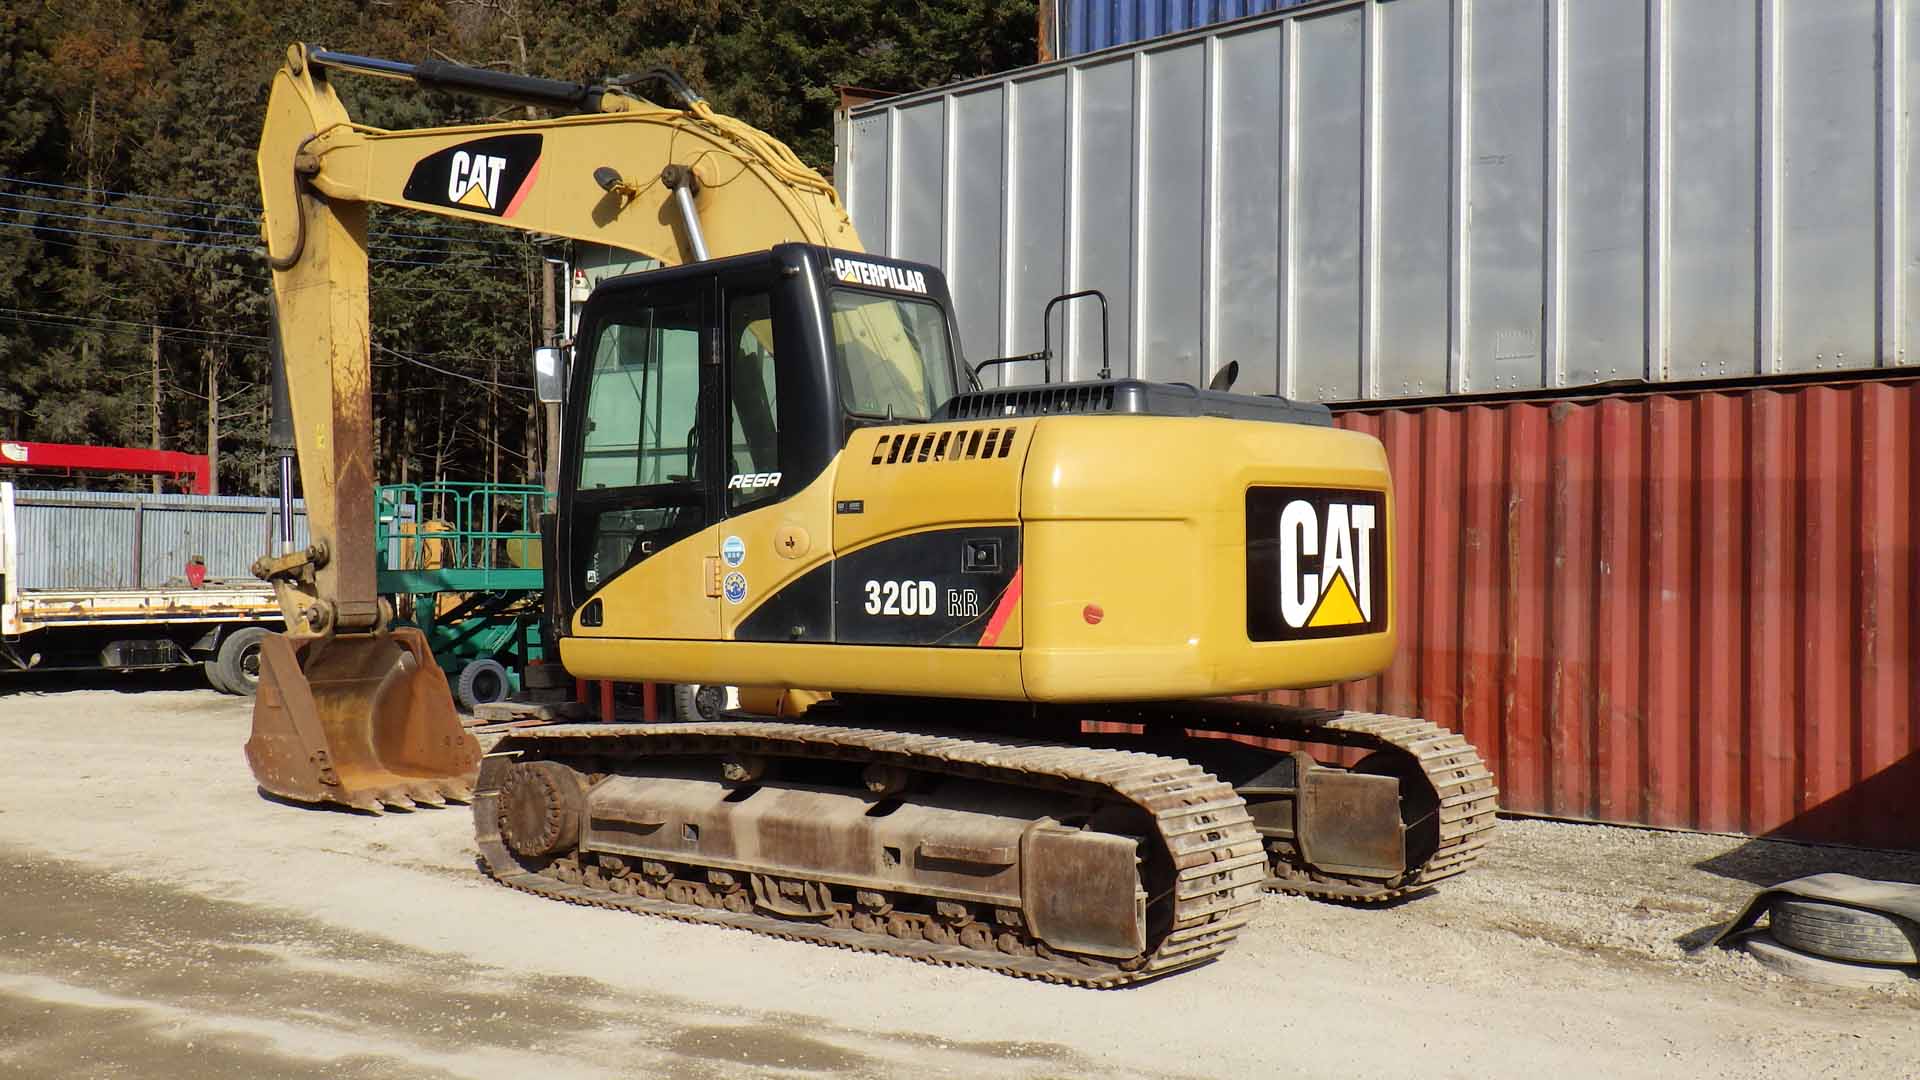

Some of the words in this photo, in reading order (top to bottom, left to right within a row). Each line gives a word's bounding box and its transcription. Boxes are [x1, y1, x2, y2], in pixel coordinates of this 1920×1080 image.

[448, 151, 507, 209] CAT
[834, 257, 928, 294] CATERPILLAR
[1280, 499, 1376, 628] CAT
[865, 580, 937, 616] 320D
[947, 588, 979, 617] RR
